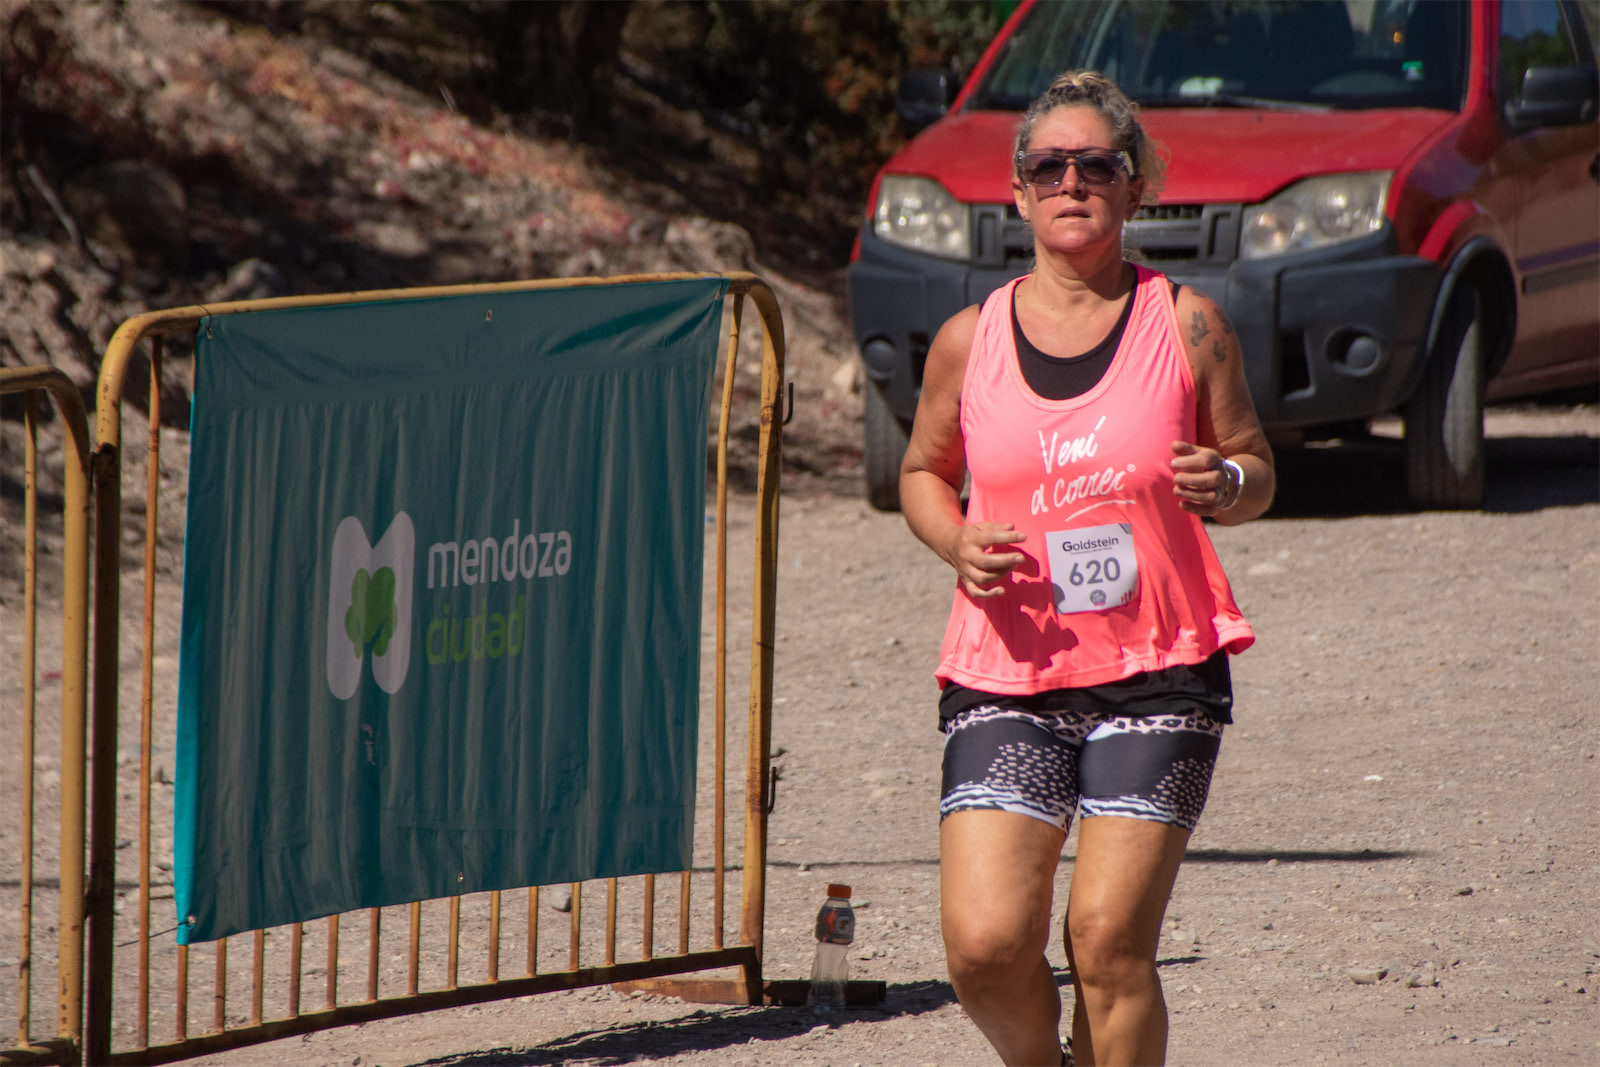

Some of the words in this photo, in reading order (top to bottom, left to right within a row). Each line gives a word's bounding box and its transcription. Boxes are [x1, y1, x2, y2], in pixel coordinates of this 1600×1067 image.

[1037, 415, 1106, 475] Vení
[1031, 483, 1049, 516] a
[427, 518, 572, 589] mendoza
[1062, 535, 1119, 552] Goldstein
[1069, 557, 1121, 586] 620
[426, 594, 525, 665] ciudad
